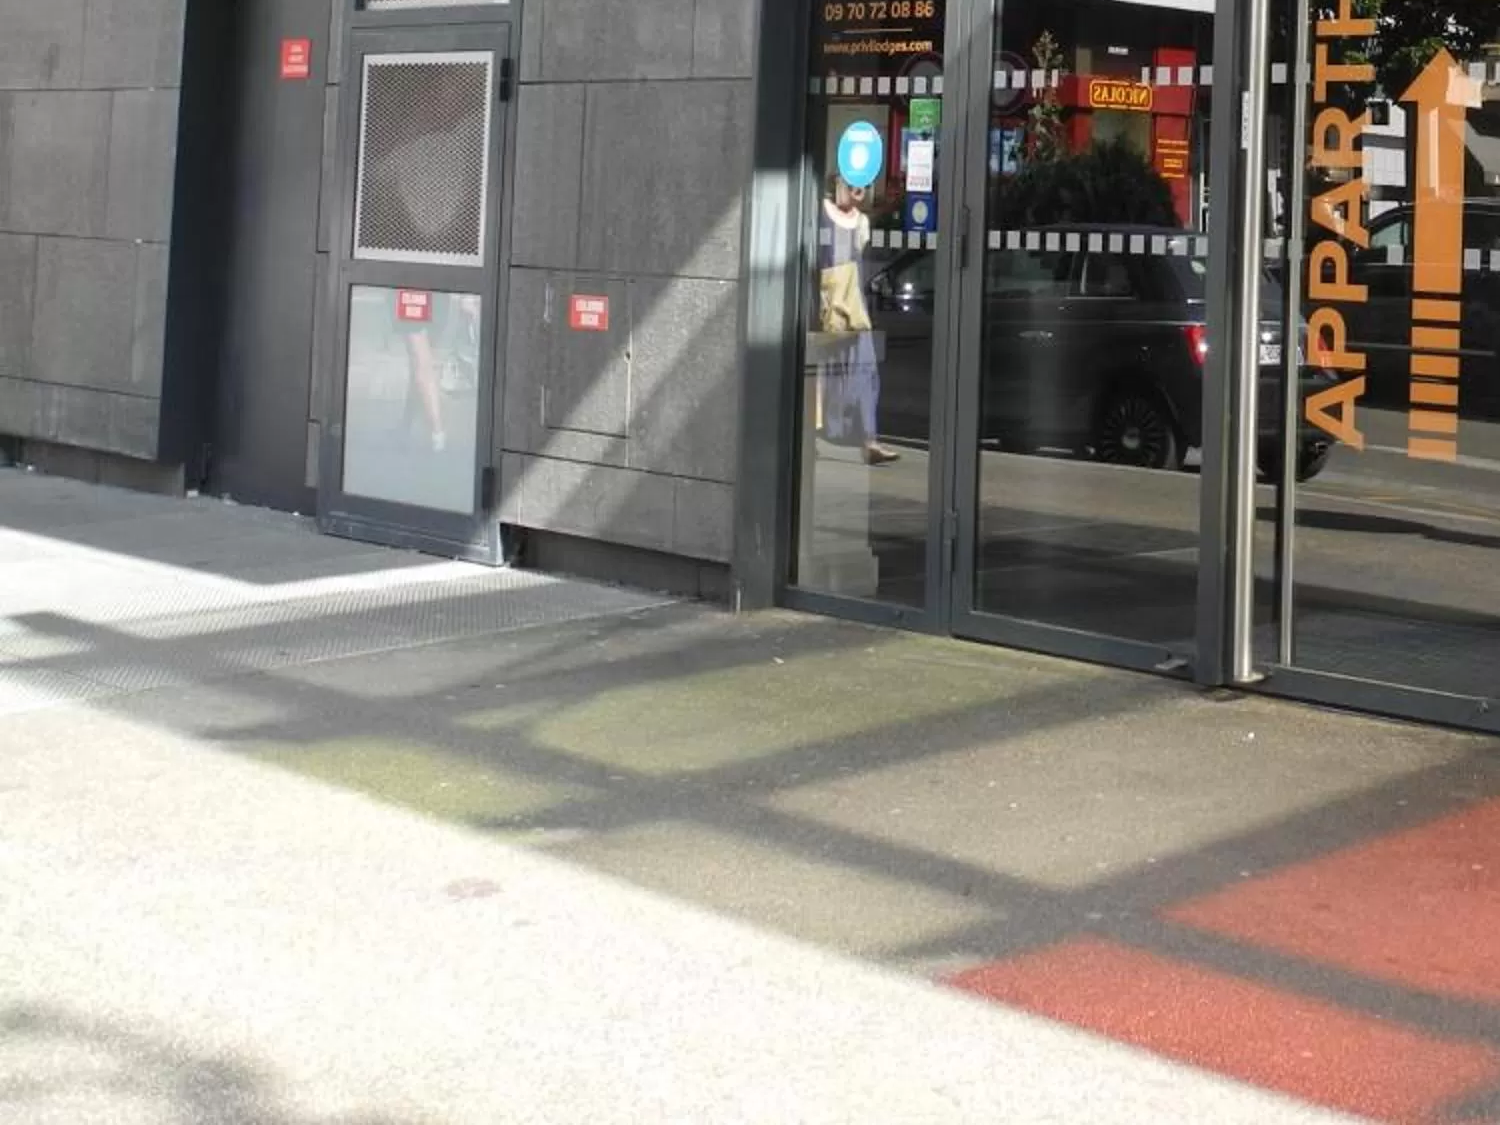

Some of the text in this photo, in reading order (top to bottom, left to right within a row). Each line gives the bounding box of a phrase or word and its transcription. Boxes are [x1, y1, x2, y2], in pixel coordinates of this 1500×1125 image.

[825, 4, 844, 21] 09
[847, 2, 865, 20] 70
[869, 1, 887, 19] 72
